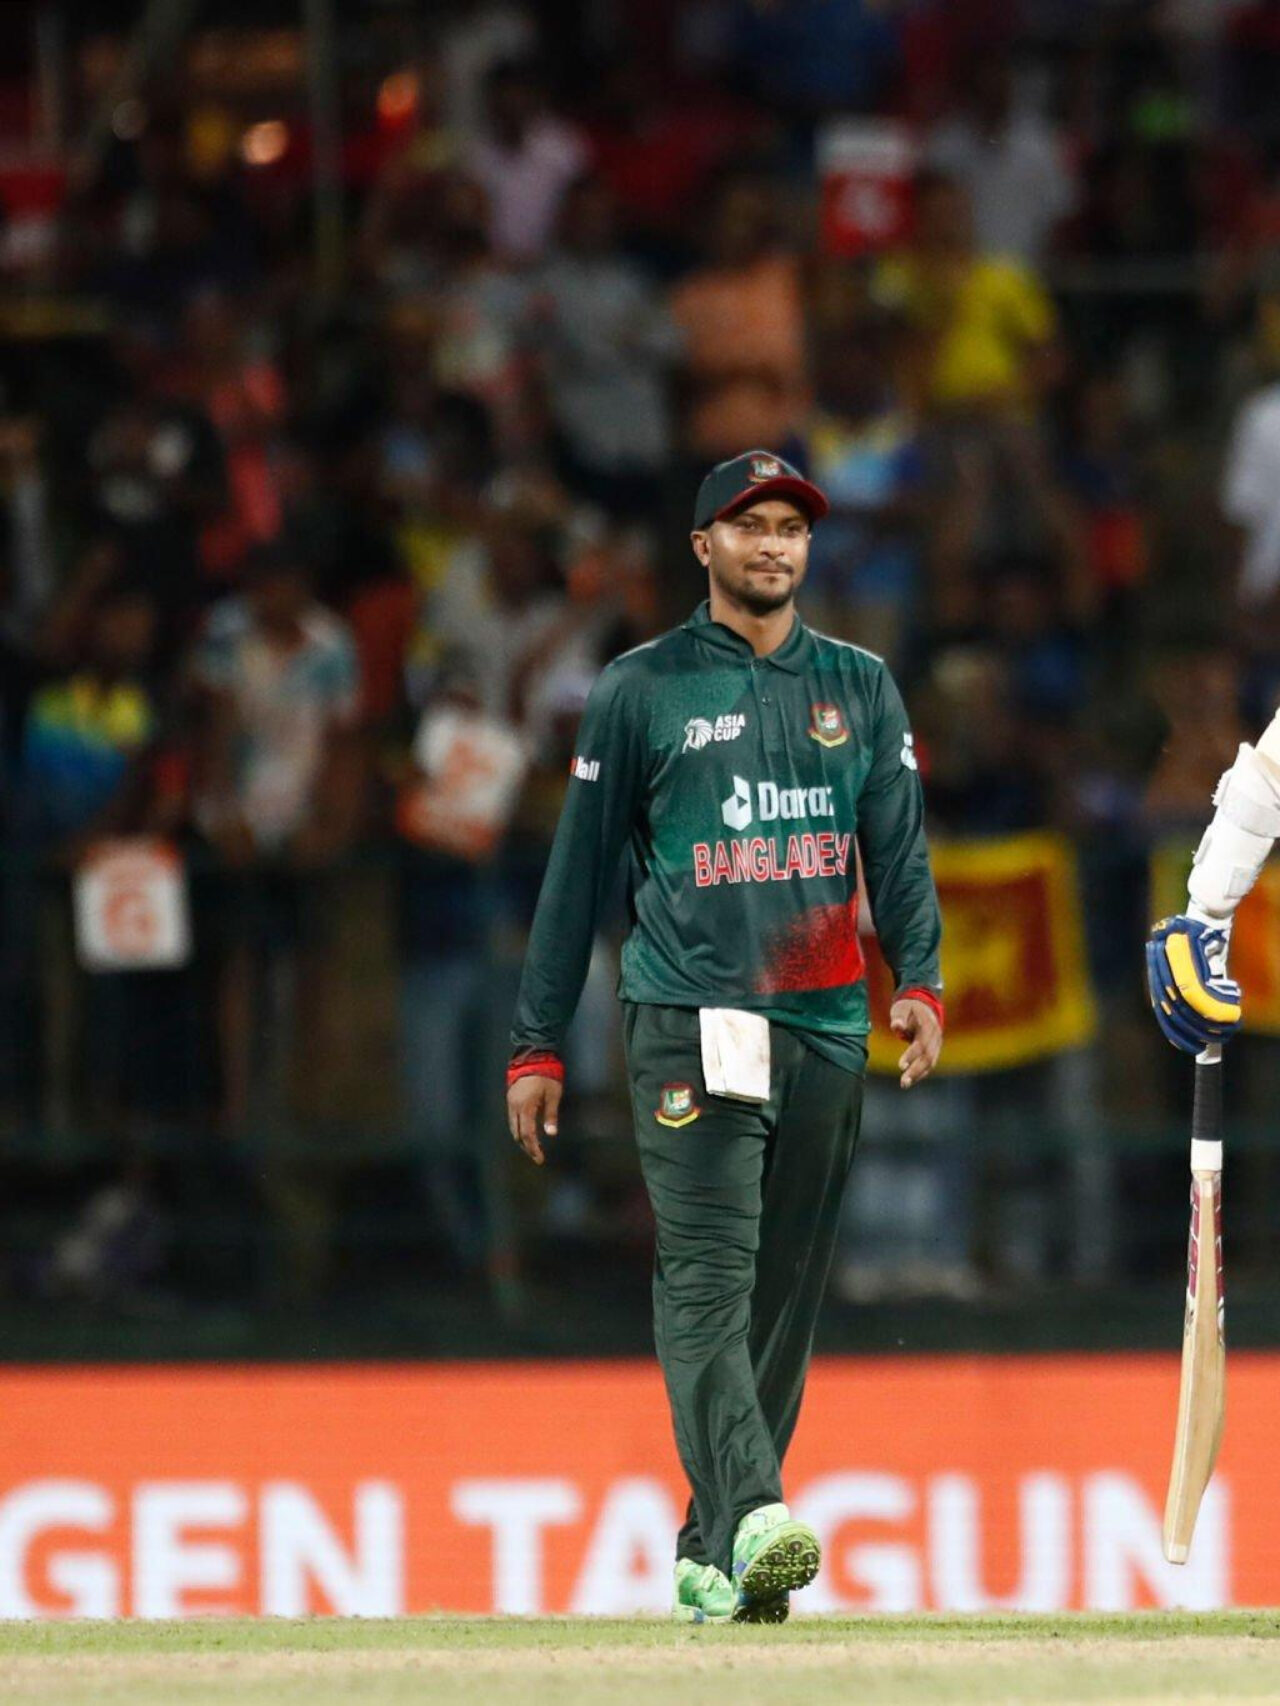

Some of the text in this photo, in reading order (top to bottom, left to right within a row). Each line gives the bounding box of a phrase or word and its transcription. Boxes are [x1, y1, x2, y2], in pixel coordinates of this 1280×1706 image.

[714, 713, 746, 728] ASIA
[713, 728, 742, 742] CUP
[0, 1472, 1232, 1619] GEN TAGUN
